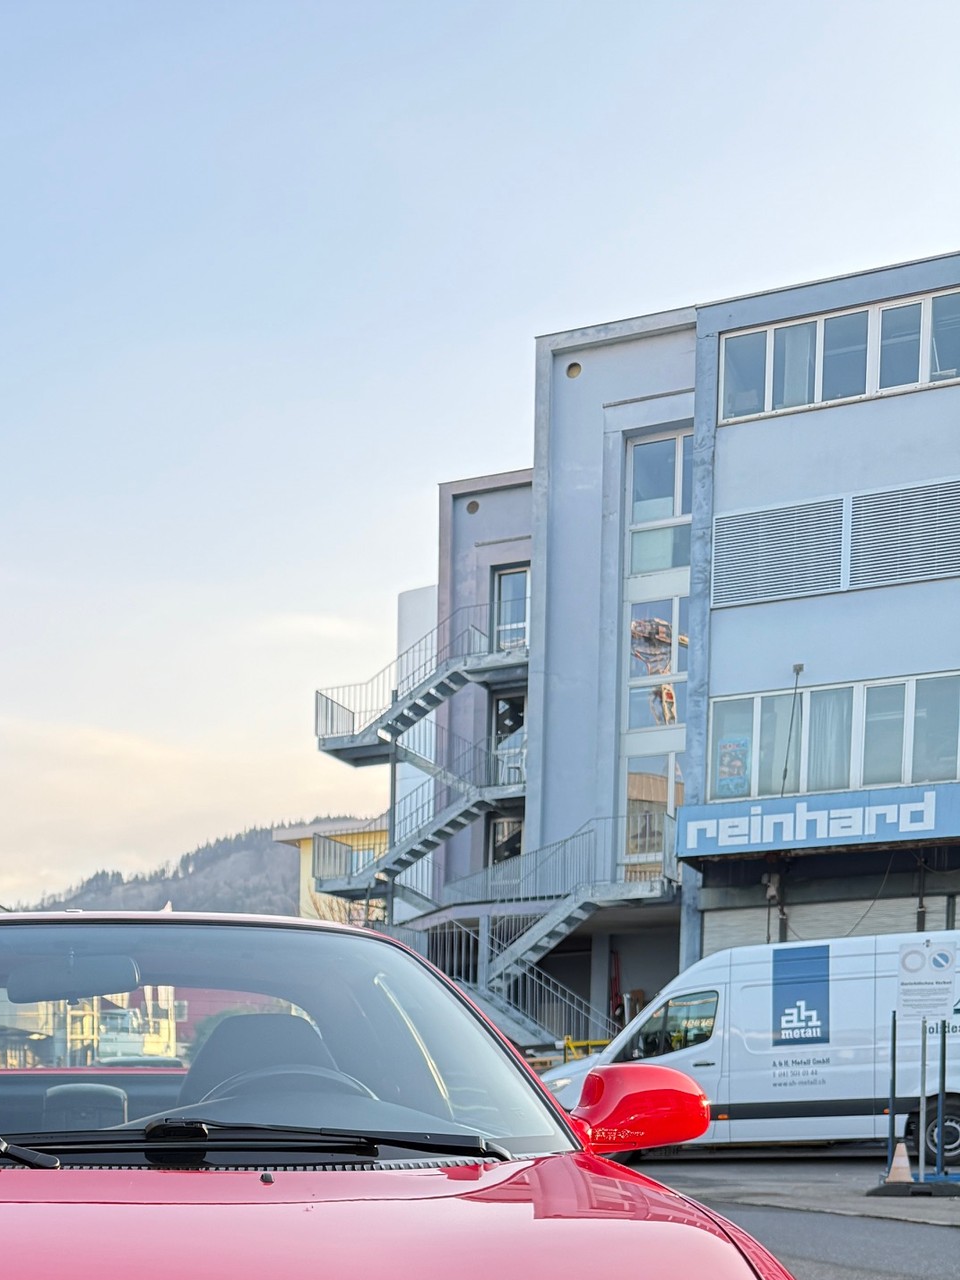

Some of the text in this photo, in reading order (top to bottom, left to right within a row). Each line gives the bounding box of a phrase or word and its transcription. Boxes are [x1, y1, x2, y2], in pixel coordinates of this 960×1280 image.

[686, 790, 937, 850] reinhard
[781, 1000, 821, 1028] ah
[781, 1027, 821, 1039] metall
